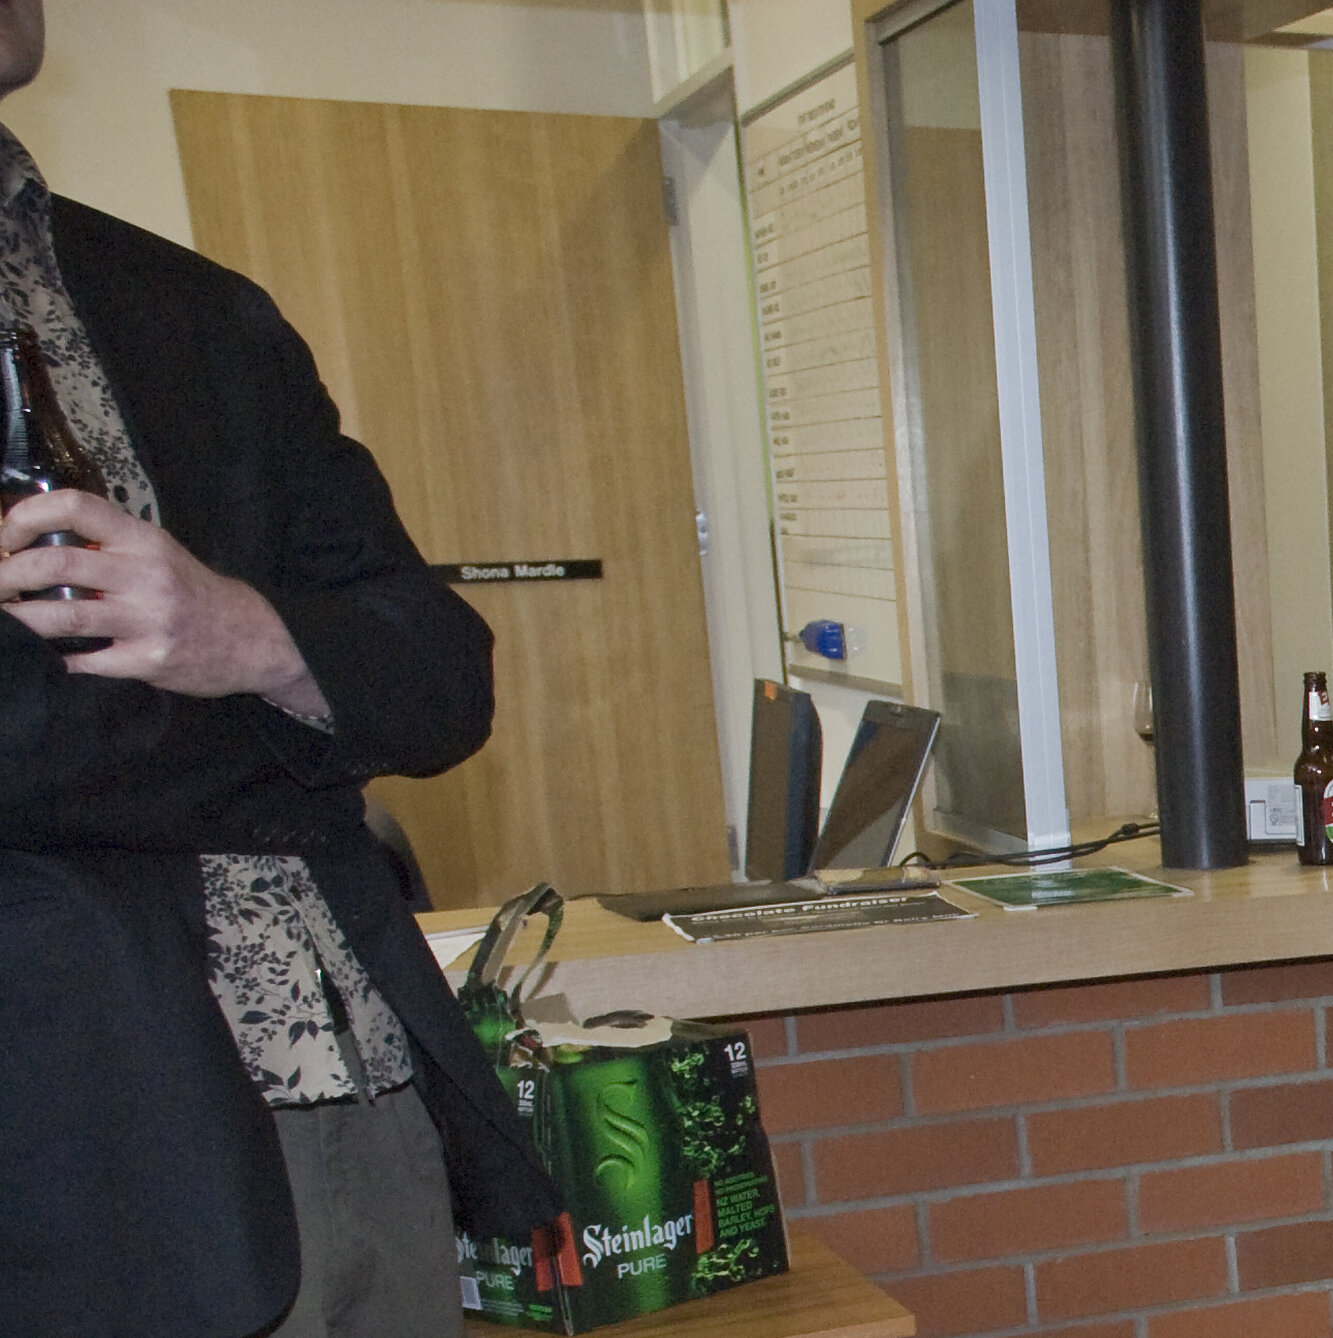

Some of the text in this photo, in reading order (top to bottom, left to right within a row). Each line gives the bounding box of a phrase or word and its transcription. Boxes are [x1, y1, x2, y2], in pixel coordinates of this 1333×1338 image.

[461, 566, 510, 580] Shona
[724, 1042, 747, 1062] 12
[517, 1080, 535, 1099] 12
[583, 1214, 694, 1269] Steinlager
[617, 1252, 668, 1279] PURE
[475, 1270, 515, 1291] PURE
